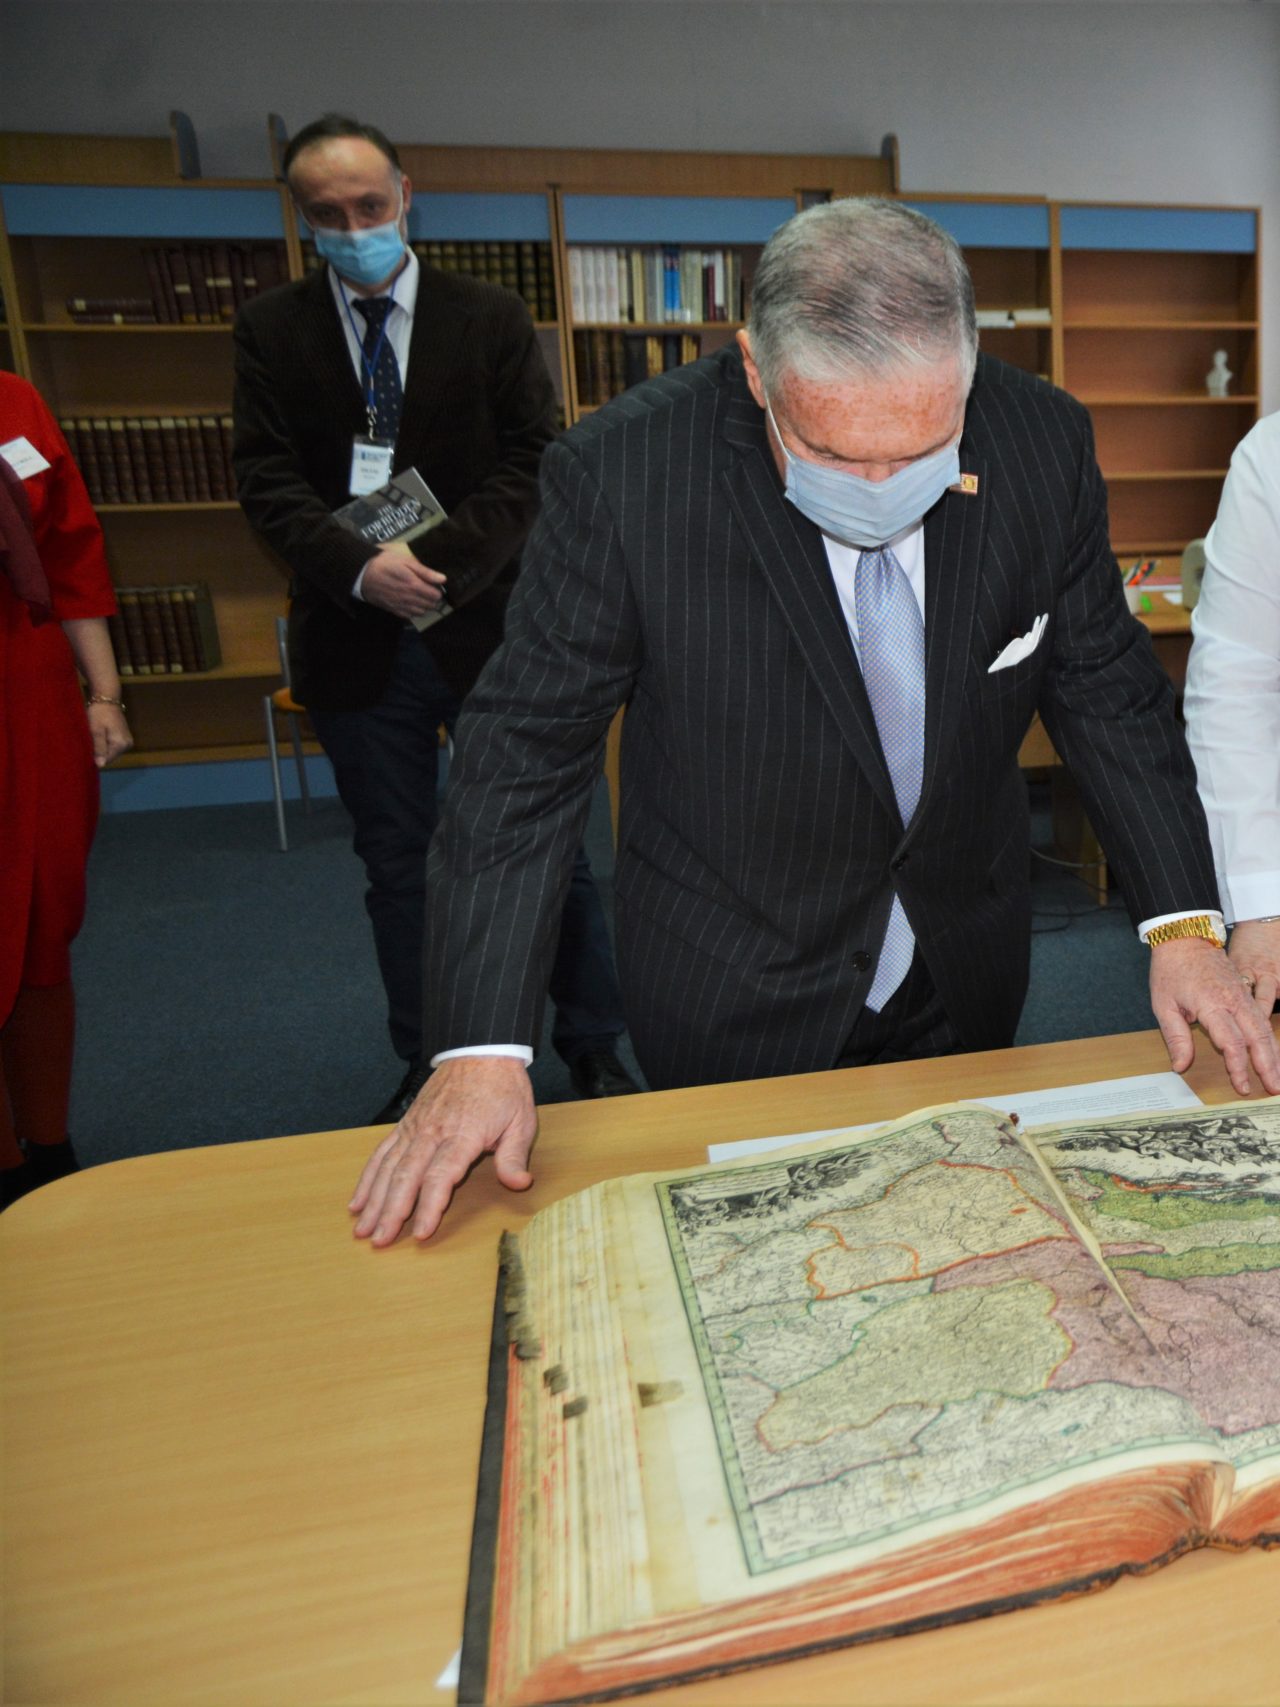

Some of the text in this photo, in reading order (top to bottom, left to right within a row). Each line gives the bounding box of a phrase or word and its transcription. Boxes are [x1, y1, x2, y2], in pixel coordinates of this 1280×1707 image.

[361, 496, 420, 539] FORBIDDEN
[377, 504, 393, 516] THE
[376, 511, 419, 542] CHURCH
